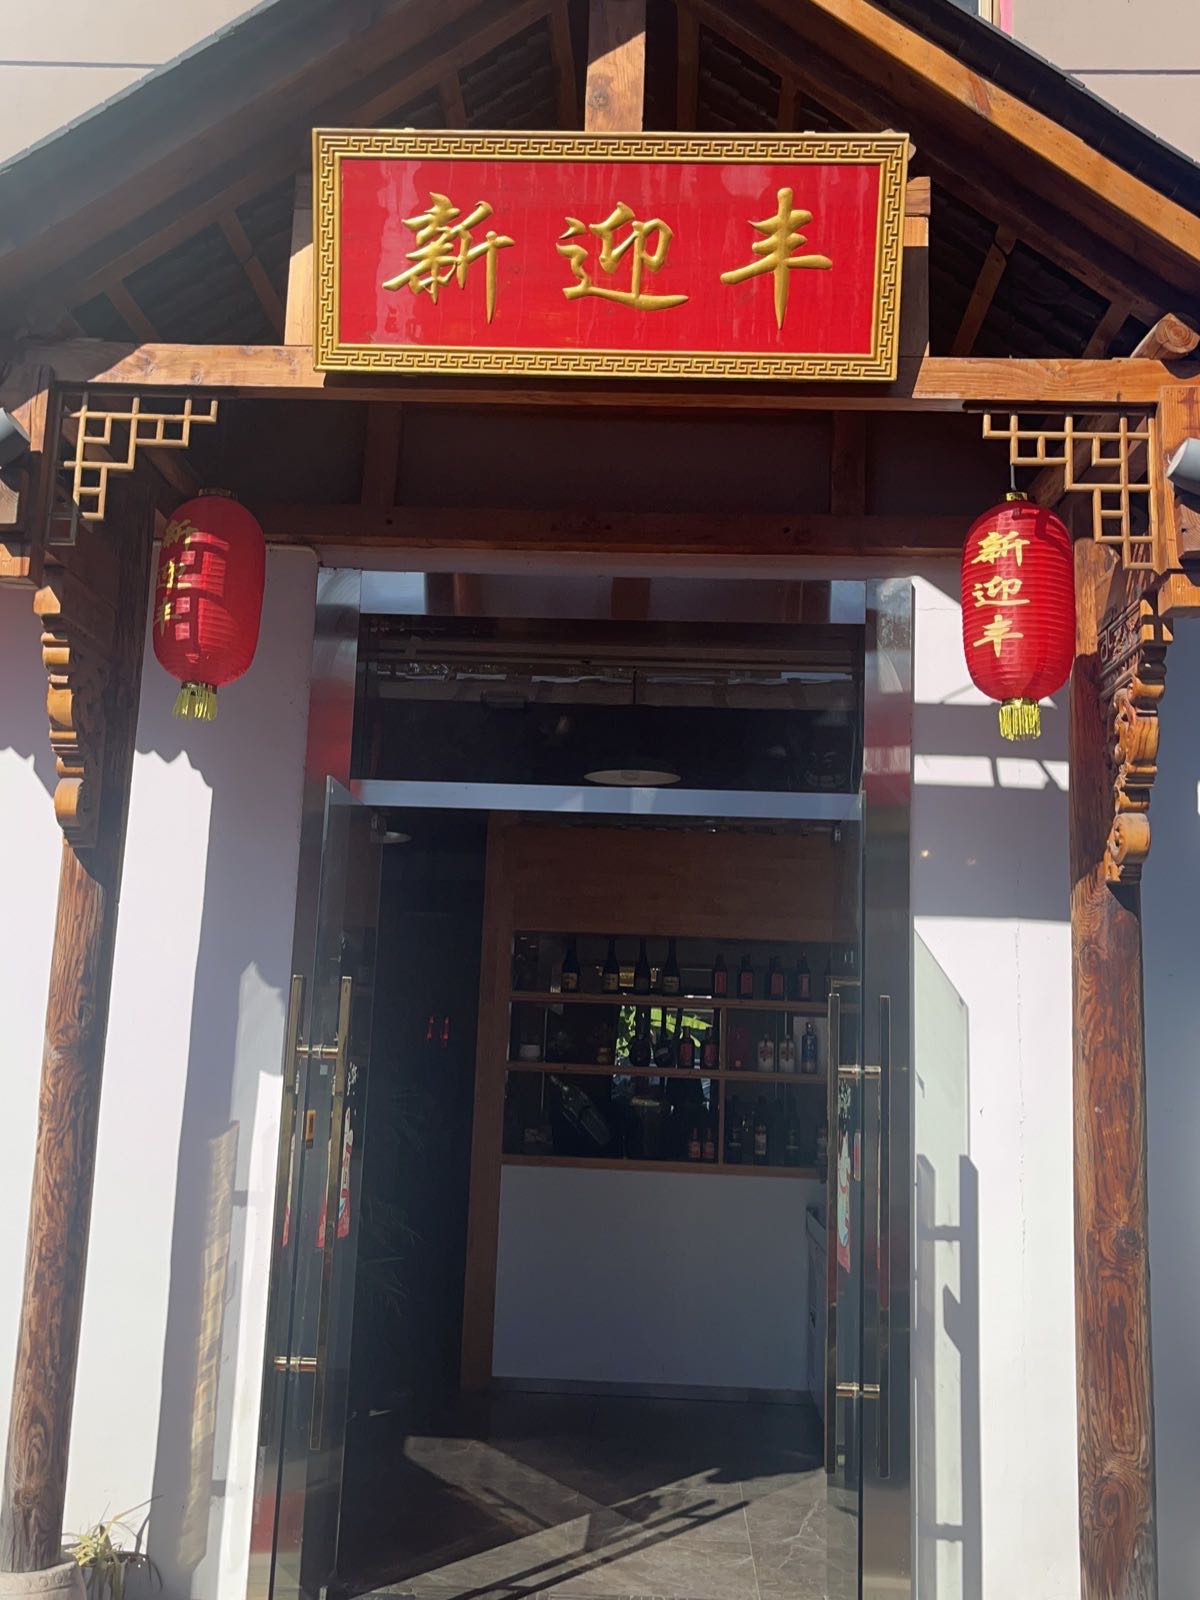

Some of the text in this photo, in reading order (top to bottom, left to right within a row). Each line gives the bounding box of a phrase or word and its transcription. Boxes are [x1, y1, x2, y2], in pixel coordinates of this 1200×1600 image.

[382, 187, 832, 330] 新迎丰
[971, 531, 1030, 658] 新迎丰
